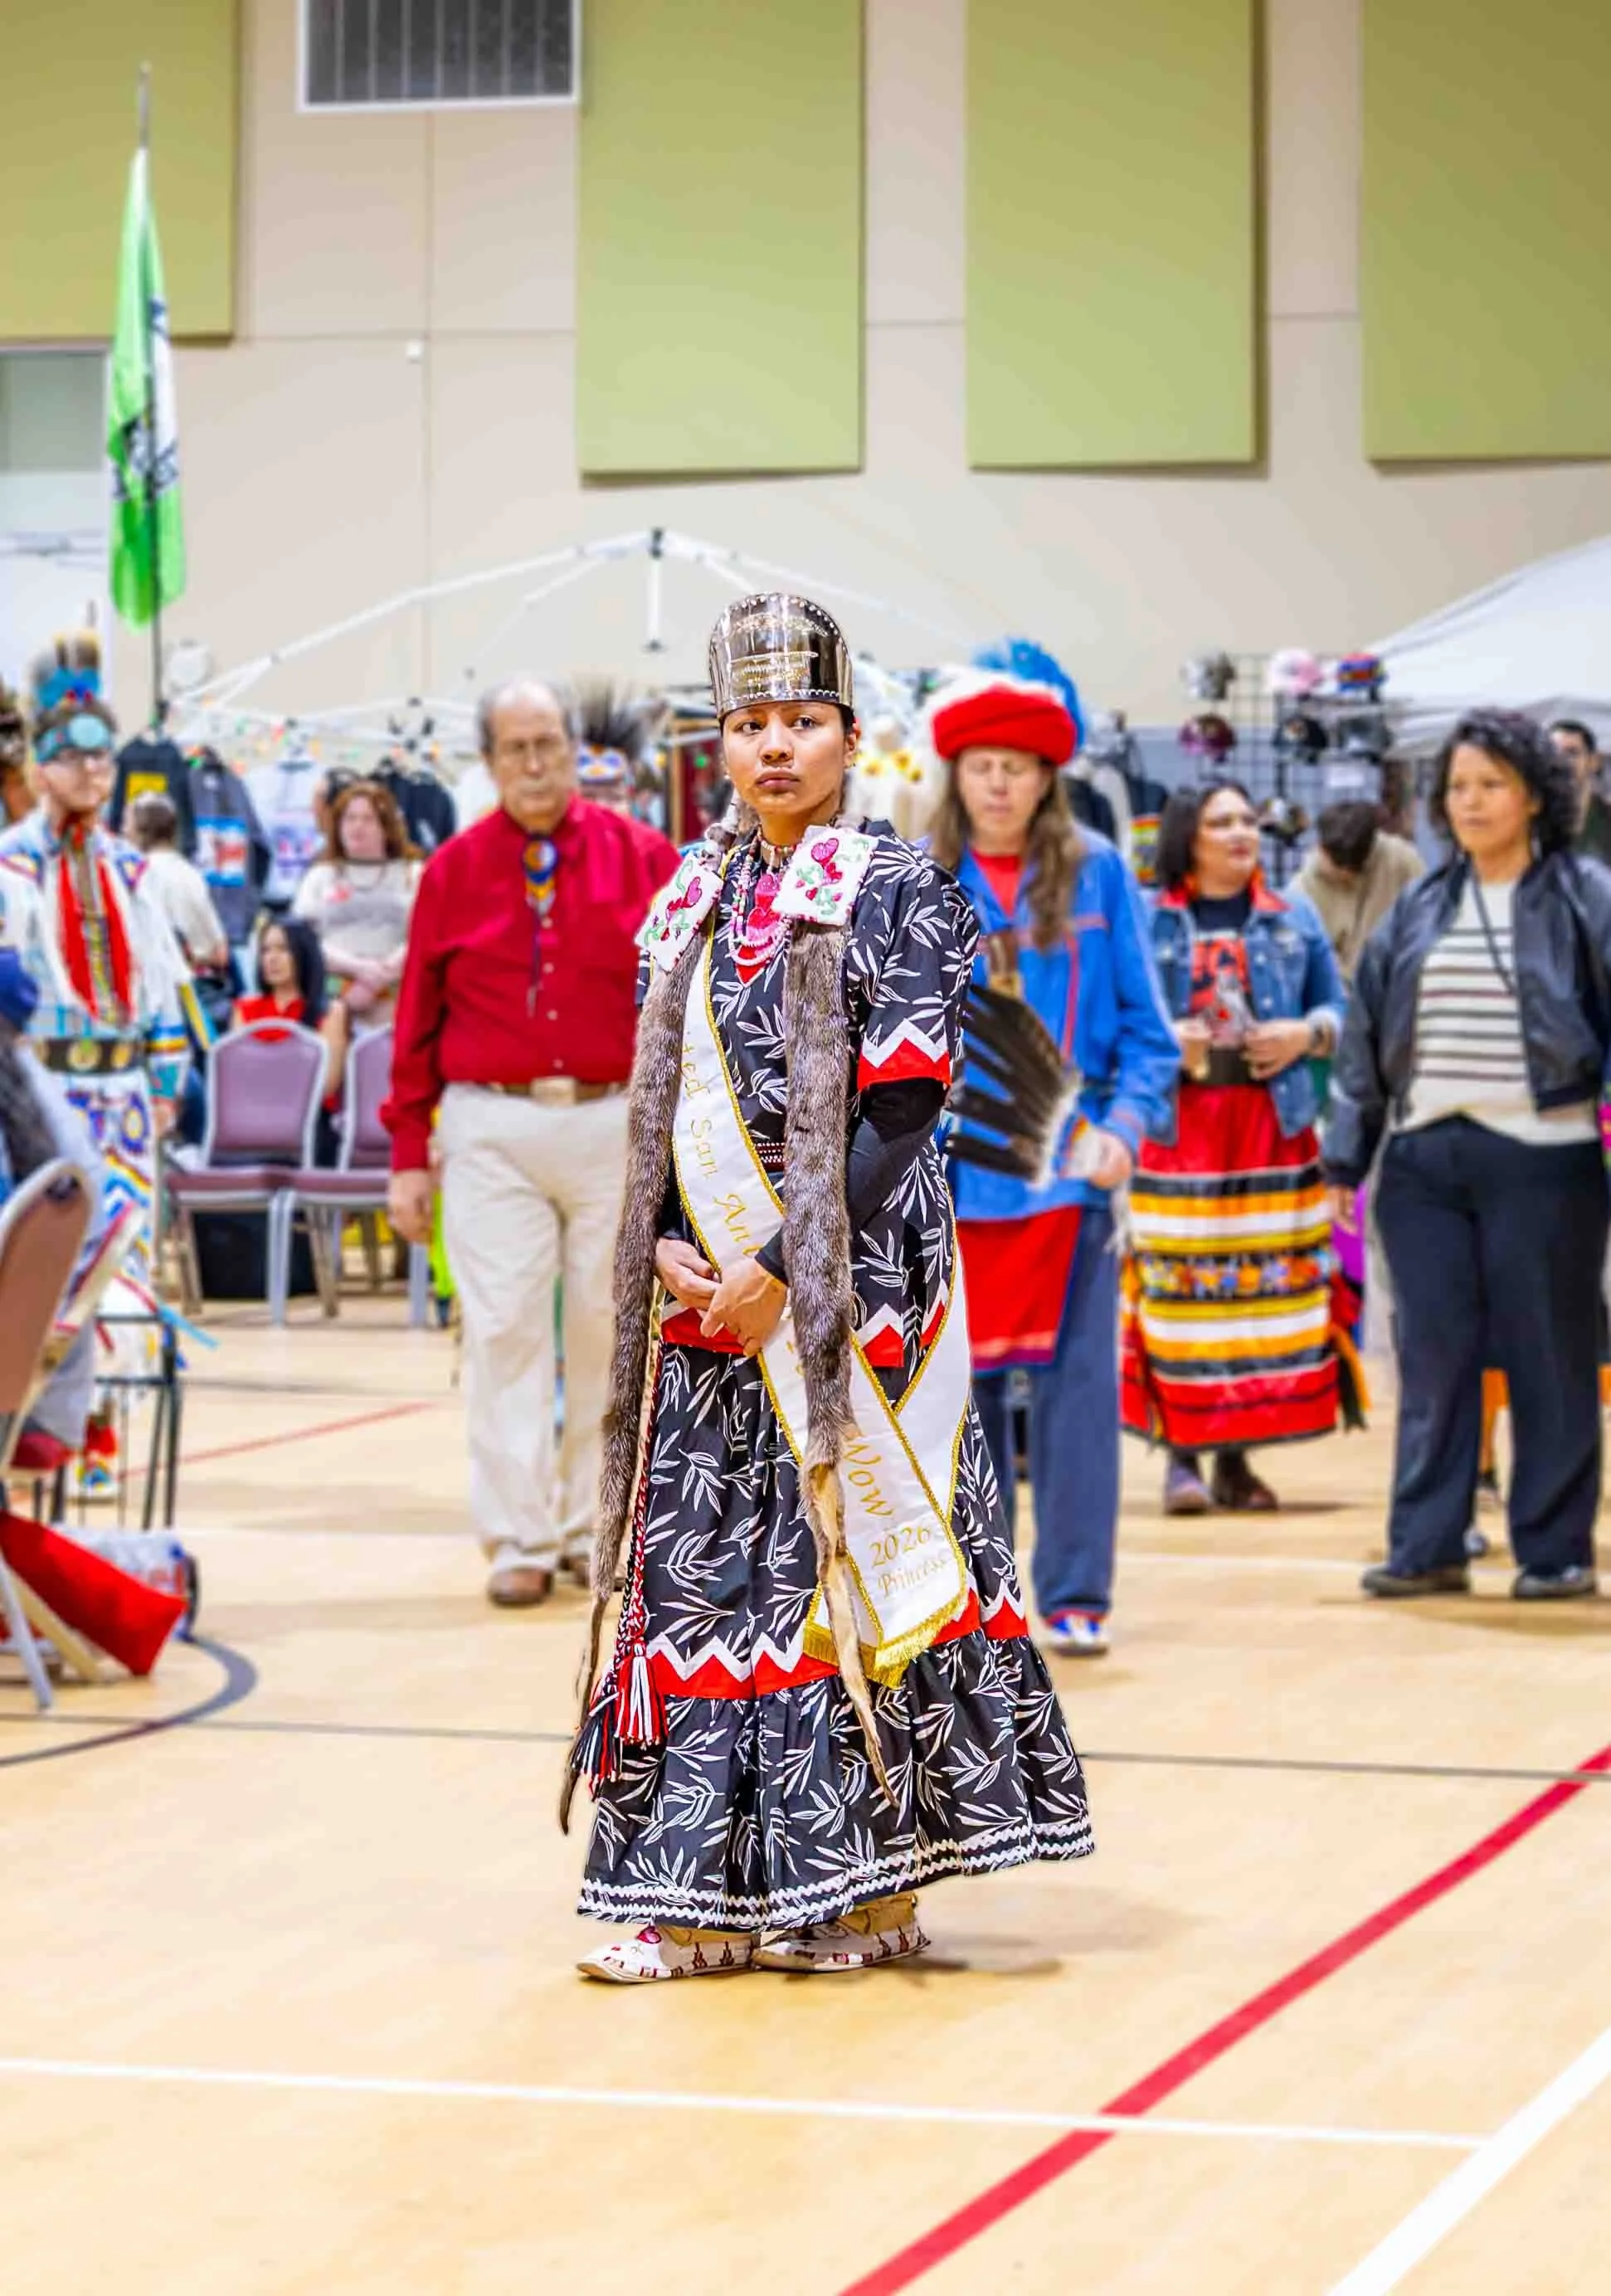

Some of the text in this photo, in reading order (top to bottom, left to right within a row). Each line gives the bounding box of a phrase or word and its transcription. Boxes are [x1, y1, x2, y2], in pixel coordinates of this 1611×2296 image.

[682, 1032, 721, 1099] ted
[690, 1117, 718, 1179] San
[869, 1525, 930, 1569] 2026
